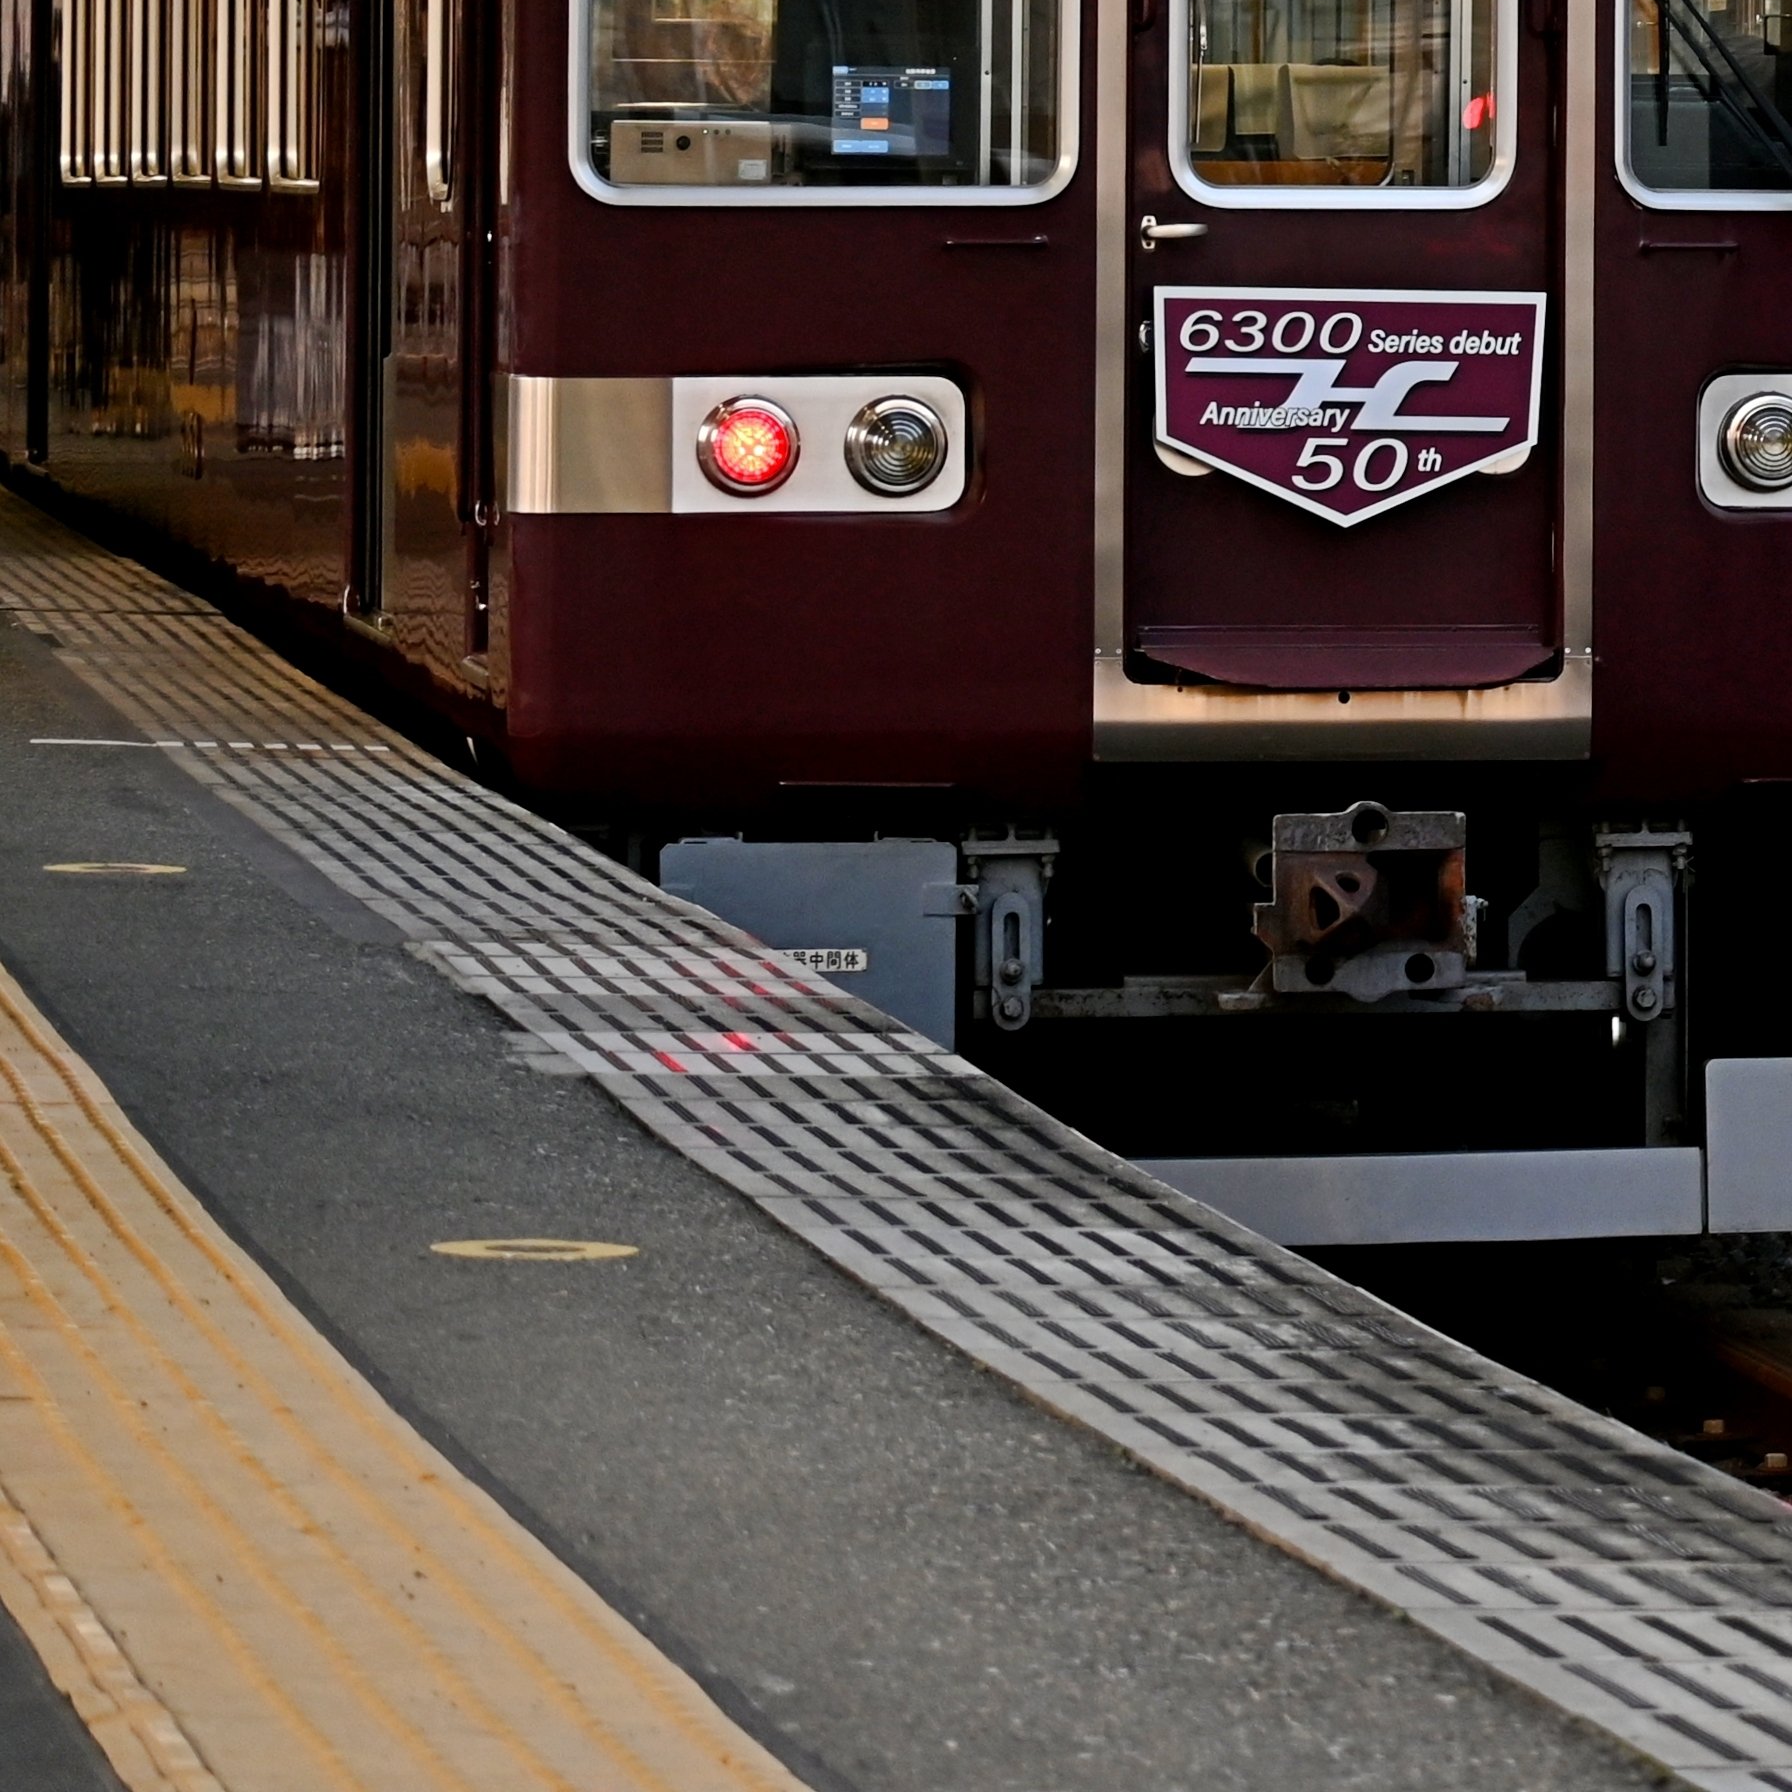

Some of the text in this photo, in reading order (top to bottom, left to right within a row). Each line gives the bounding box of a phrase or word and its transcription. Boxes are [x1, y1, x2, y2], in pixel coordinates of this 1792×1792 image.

[1179, 309, 1522, 356] 6300 Series debut
[1199, 401, 1350, 432] Anniversary
[783, 951, 859, 969] 器中間体
